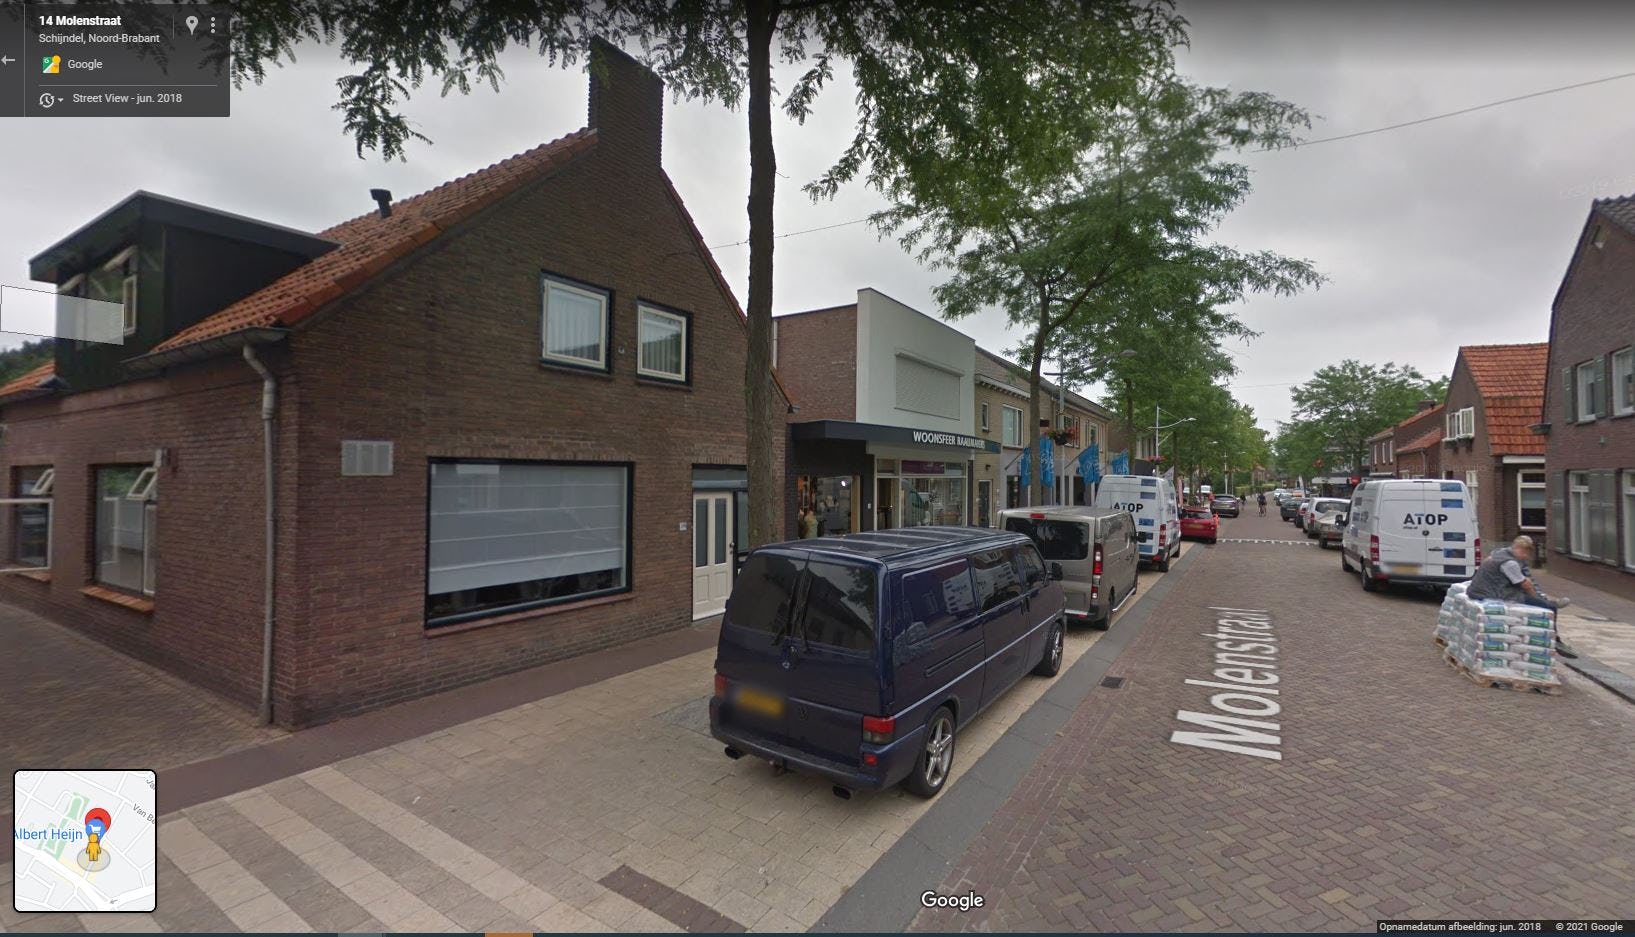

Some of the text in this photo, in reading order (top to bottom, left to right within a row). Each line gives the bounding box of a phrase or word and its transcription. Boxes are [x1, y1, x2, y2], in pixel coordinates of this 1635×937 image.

[912, 430, 956, 446] WOONSFEER
[1113, 502, 1144, 513] ATOP
[1403, 512, 1448, 526] ATOP
[1170, 606, 1283, 761] Molenstraat
